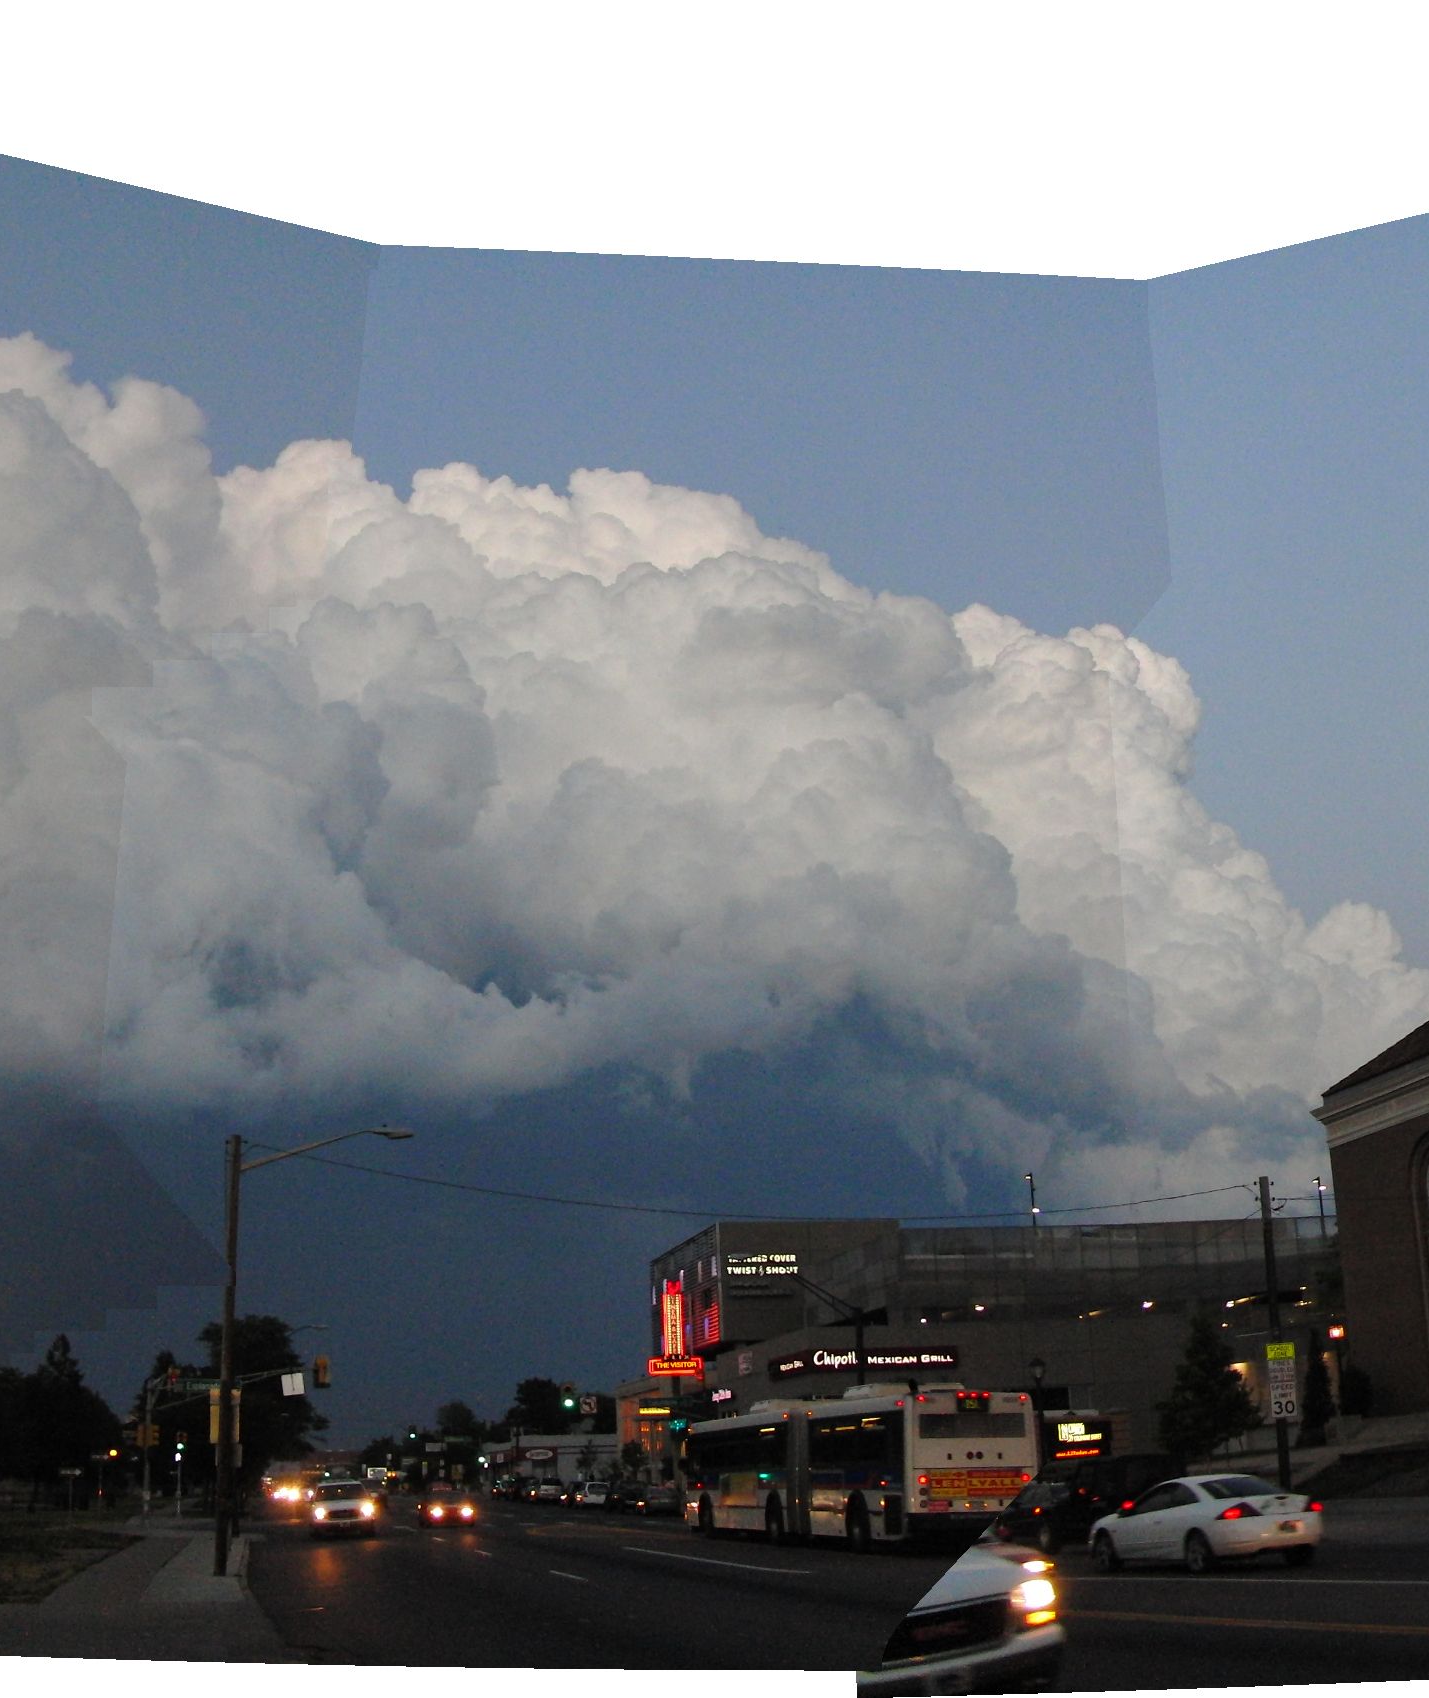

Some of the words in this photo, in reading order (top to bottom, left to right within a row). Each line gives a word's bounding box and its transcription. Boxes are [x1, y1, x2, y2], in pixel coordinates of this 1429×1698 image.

[769, 1254, 796, 1263] COVER
[726, 1266, 757, 1275] TWIST
[765, 1266, 799, 1275] SHOUT
[813, 1351, 859, 1369] Chipotl
[868, 1356, 917, 1364] MEXICAN
[920, 1354, 954, 1363] GRILL
[1274, 1400, 1295, 1415] 30
